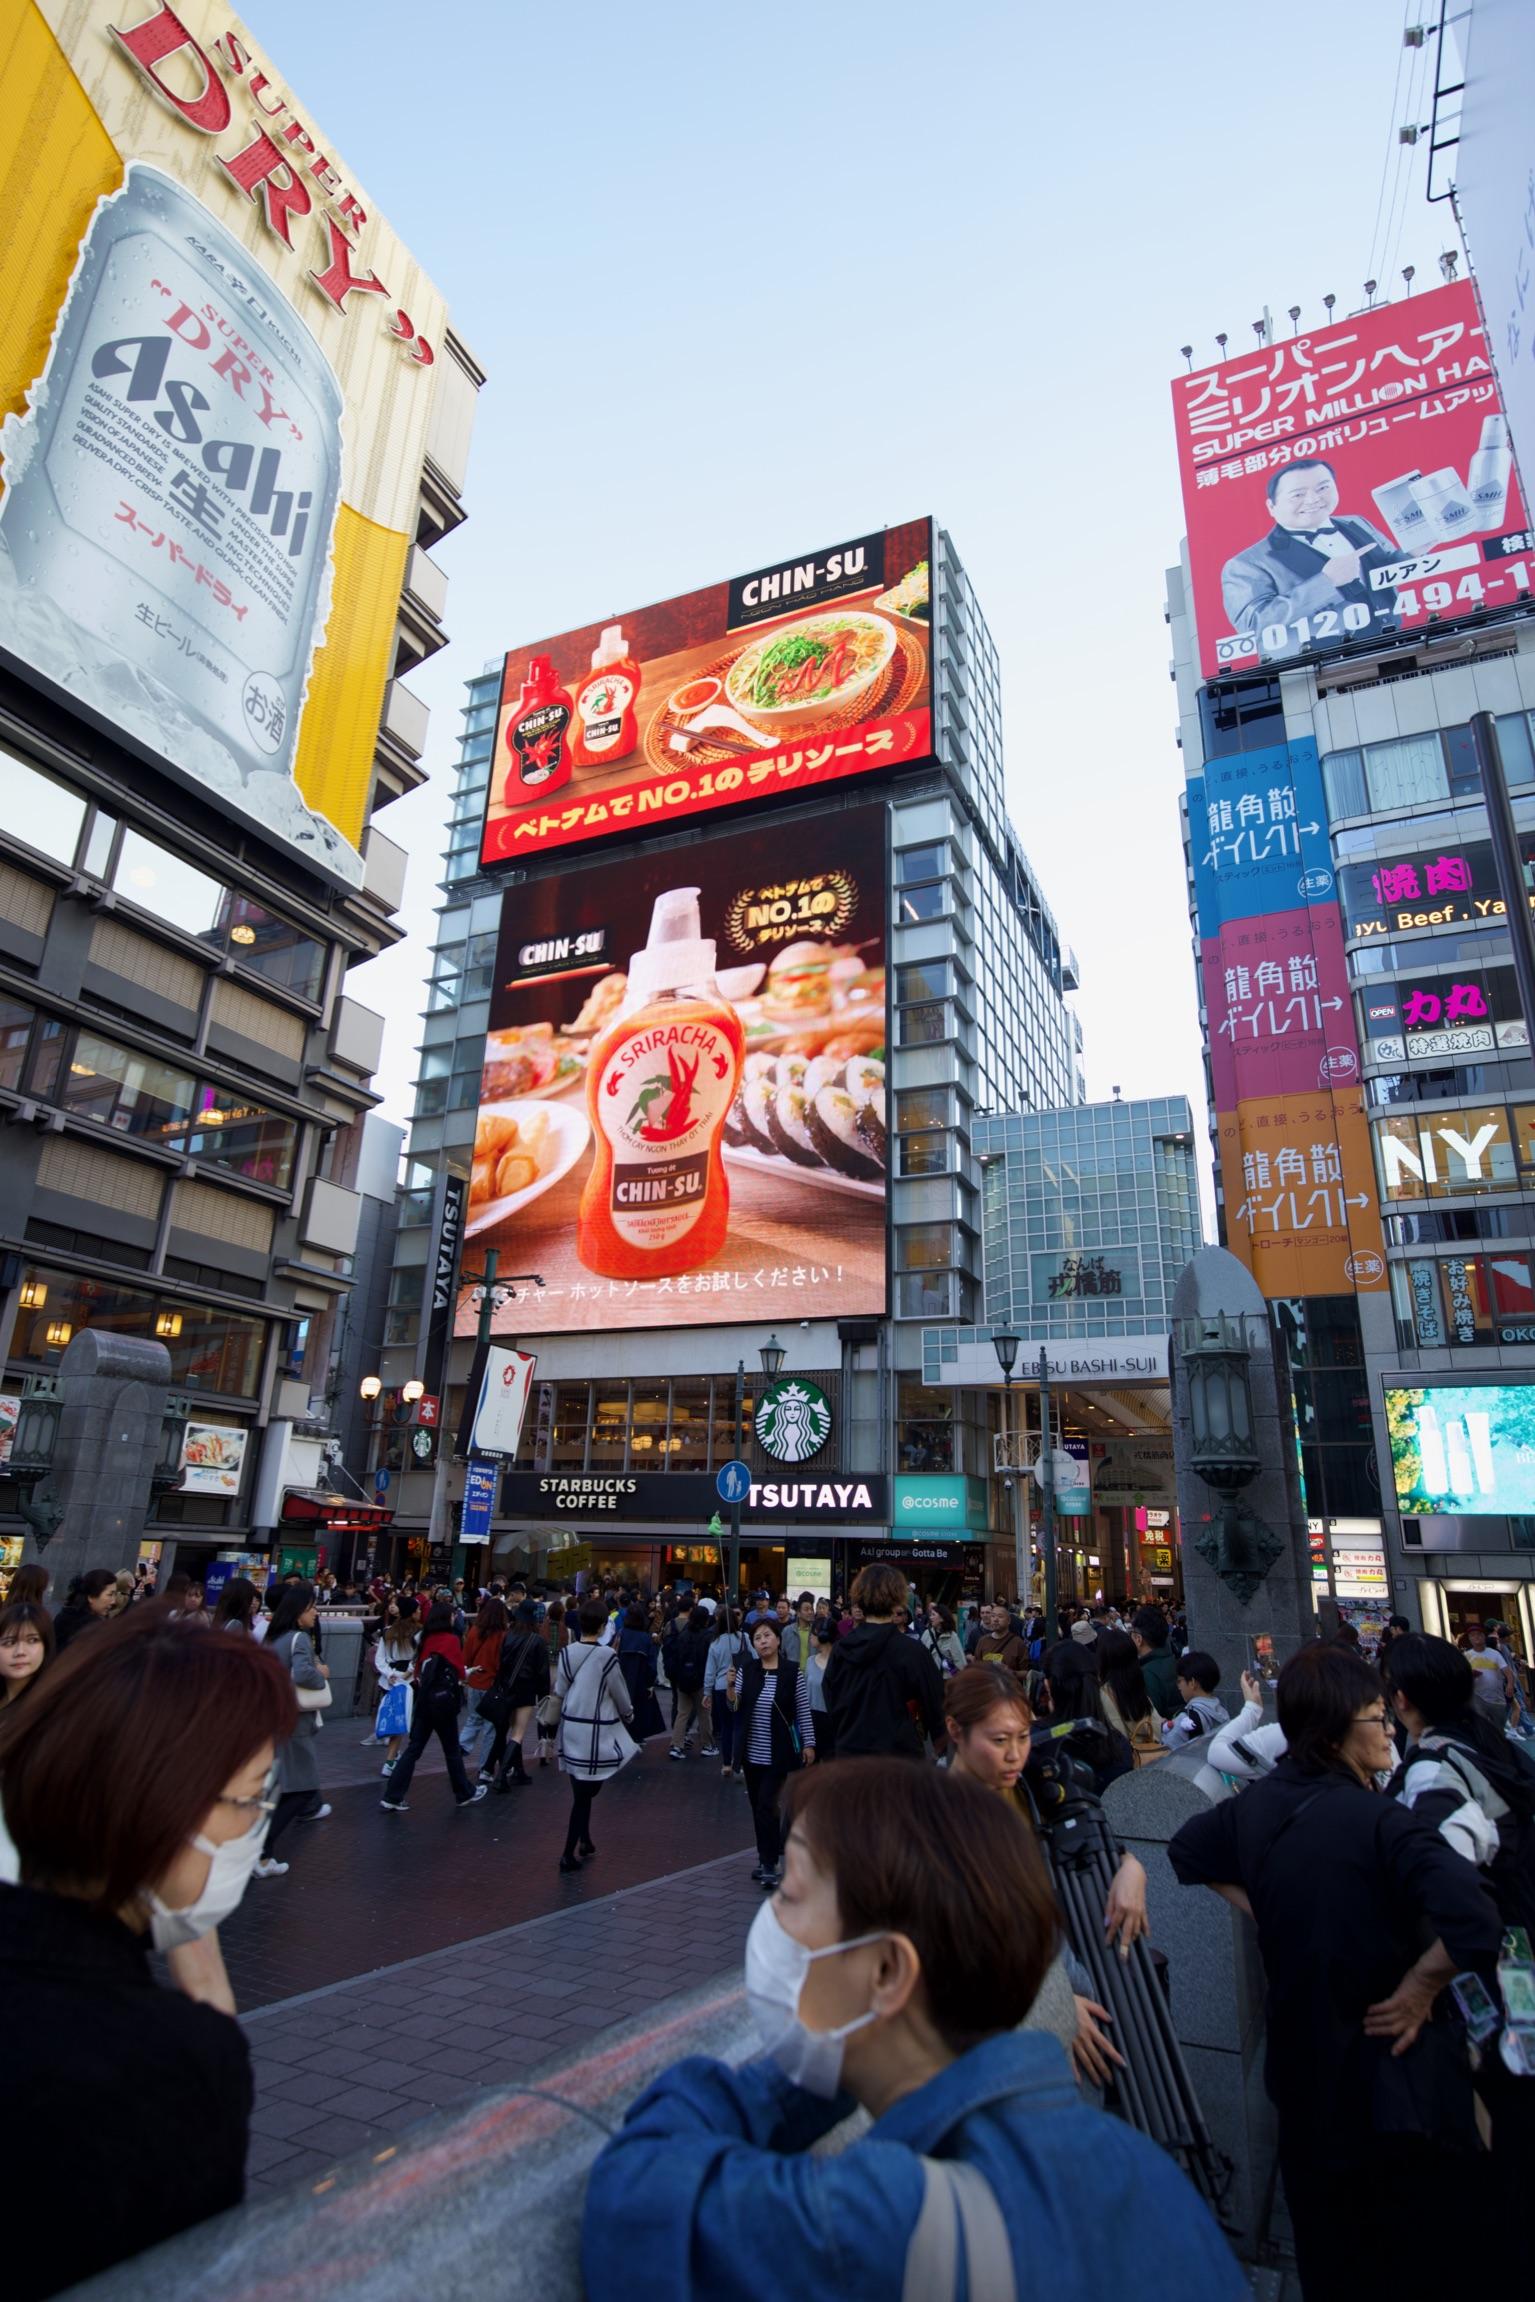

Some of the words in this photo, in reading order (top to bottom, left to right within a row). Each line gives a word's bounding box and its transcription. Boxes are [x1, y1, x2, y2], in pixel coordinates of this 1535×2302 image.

[214, 31, 368, 238] SUPER
[201, 304, 274, 387] SUPER
[1186, 334, 1358, 408] スーパー
[84, 394, 118, 421] QUALITY
[1192, 415, 1294, 461] SUPER
[1305, 373, 1428, 426] MILLION
[76, 419, 92, 437] OUR
[90, 432, 137, 471] ADVANCED
[80, 407, 107, 431] VISION
[118, 434, 165, 475] JAPANESE
[91, 336, 312, 556] Asahi
[88, 382, 113, 402] ASAHI
[113, 399, 141, 425] SUPER
[142, 422, 163, 441] DRY
[162, 438, 172, 449] IS
[172, 448, 210, 485] BREWED
[211, 483, 236, 508] WITH
[235, 506, 274, 550] PRECISION
[72, 432, 108, 463] DELIVER
[134, 477, 164, 504] CRISP
[162, 499, 193, 530] TASTE
[191, 527, 215, 550] AND
[243, 574, 269, 604] CLEAN
[169, 469, 226, 542] 生
[114, 500, 249, 623] スーパードライ
[228, 530, 264, 566] MASTER
[231, 516, 260, 551] UNDER
[260, 547, 275, 563] THE
[225, 542, 245, 562] ING
[244, 559, 291, 613] TECHNIQUES
[742, 547, 866, 606] CHIN-SU
[1378, 559, 1440, 585] ルアン
[135, 602, 196, 657] 生ビール
[245, 684, 286, 745] お酒
[518, 707, 564, 732] CHIN-SU
[586, 723, 619, 738] CHIN-SU
[1208, 785, 1298, 836] 龍角散
[1202, 821, 1319, 870] ダイレクト
[1372, 856, 1472, 904] 焼肉
[1397, 905, 1454, 930] Beef
[519, 930, 605, 967] CHIN-SU
[1224, 953, 1321, 1004] 龍角散
[1218, 994, 1343, 1042] ダイレクト
[1370, 1007, 1395, 1017] OPEN
[1402, 984, 1488, 1025] 力丸
[621, 1026, 717, 1068] SRIRACHA
[1243, 1142, 1343, 1192] 龍角散
[1381, 1123, 1499, 1186] NY
[617, 1172, 701, 1202] CHIN-SU
[1236, 1187, 1368, 1234] ダイレクト
[433, 1190, 461, 1309] TSUTAYA
[1063, 1256, 1105, 1271] なんば
[1048, 1270, 1121, 1298] 戎橋筋
[1412, 1269, 1439, 1339] 焼きそば
[1447, 1259, 1474, 1342] お好み焼き
[1022, 1359, 1067, 1376] EBSU
[539, 1478, 637, 1493] STARBUCKS
[556, 1494, 617, 1509] COFFEE
[748, 1484, 873, 1509] TSUTAYA
[902, 1495, 959, 1509] @cosme
[911, 1548, 936, 1558] Gotta
[937, 1549, 948, 1558] Be
